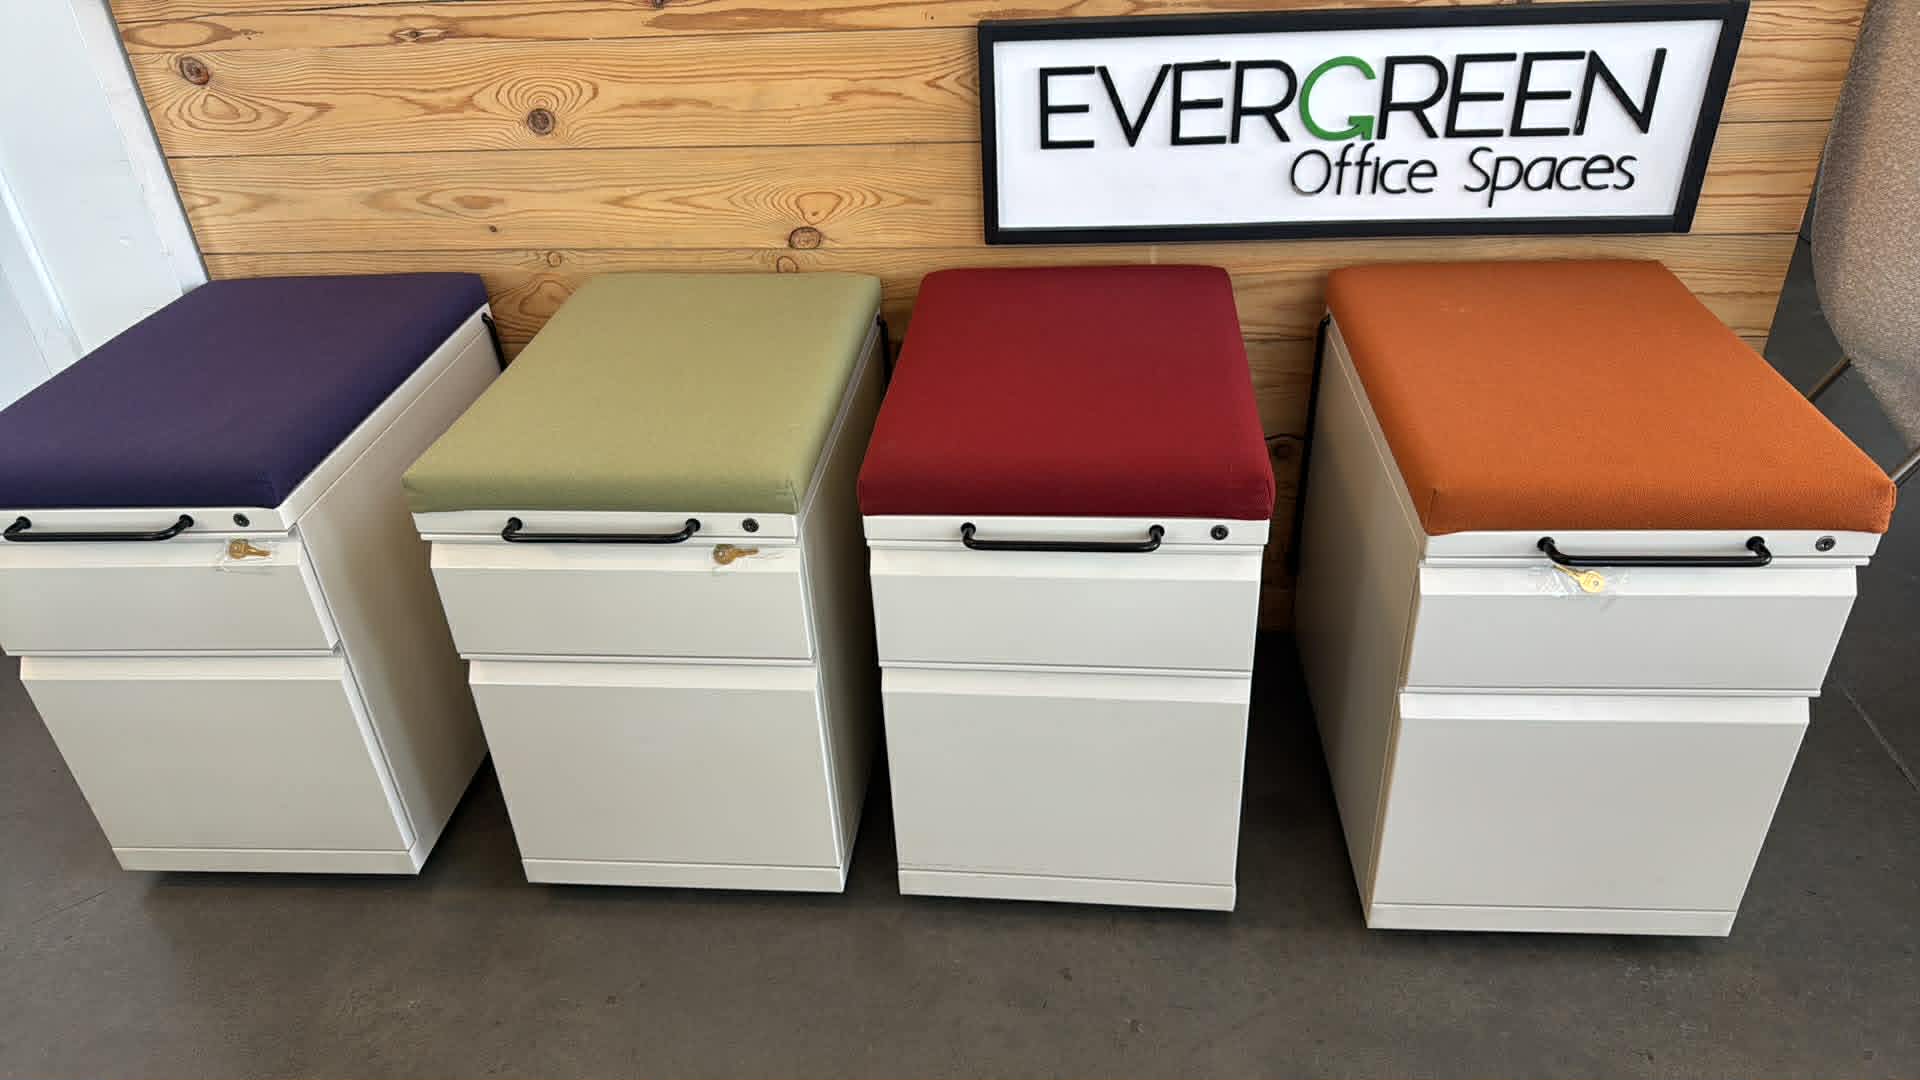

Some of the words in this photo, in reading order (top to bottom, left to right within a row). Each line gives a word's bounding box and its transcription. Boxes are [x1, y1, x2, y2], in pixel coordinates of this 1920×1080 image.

[1039, 48, 1667, 150] EVERGREEN
[1290, 142, 1438, 197] Office
[1464, 147, 1636, 208] Spaces
